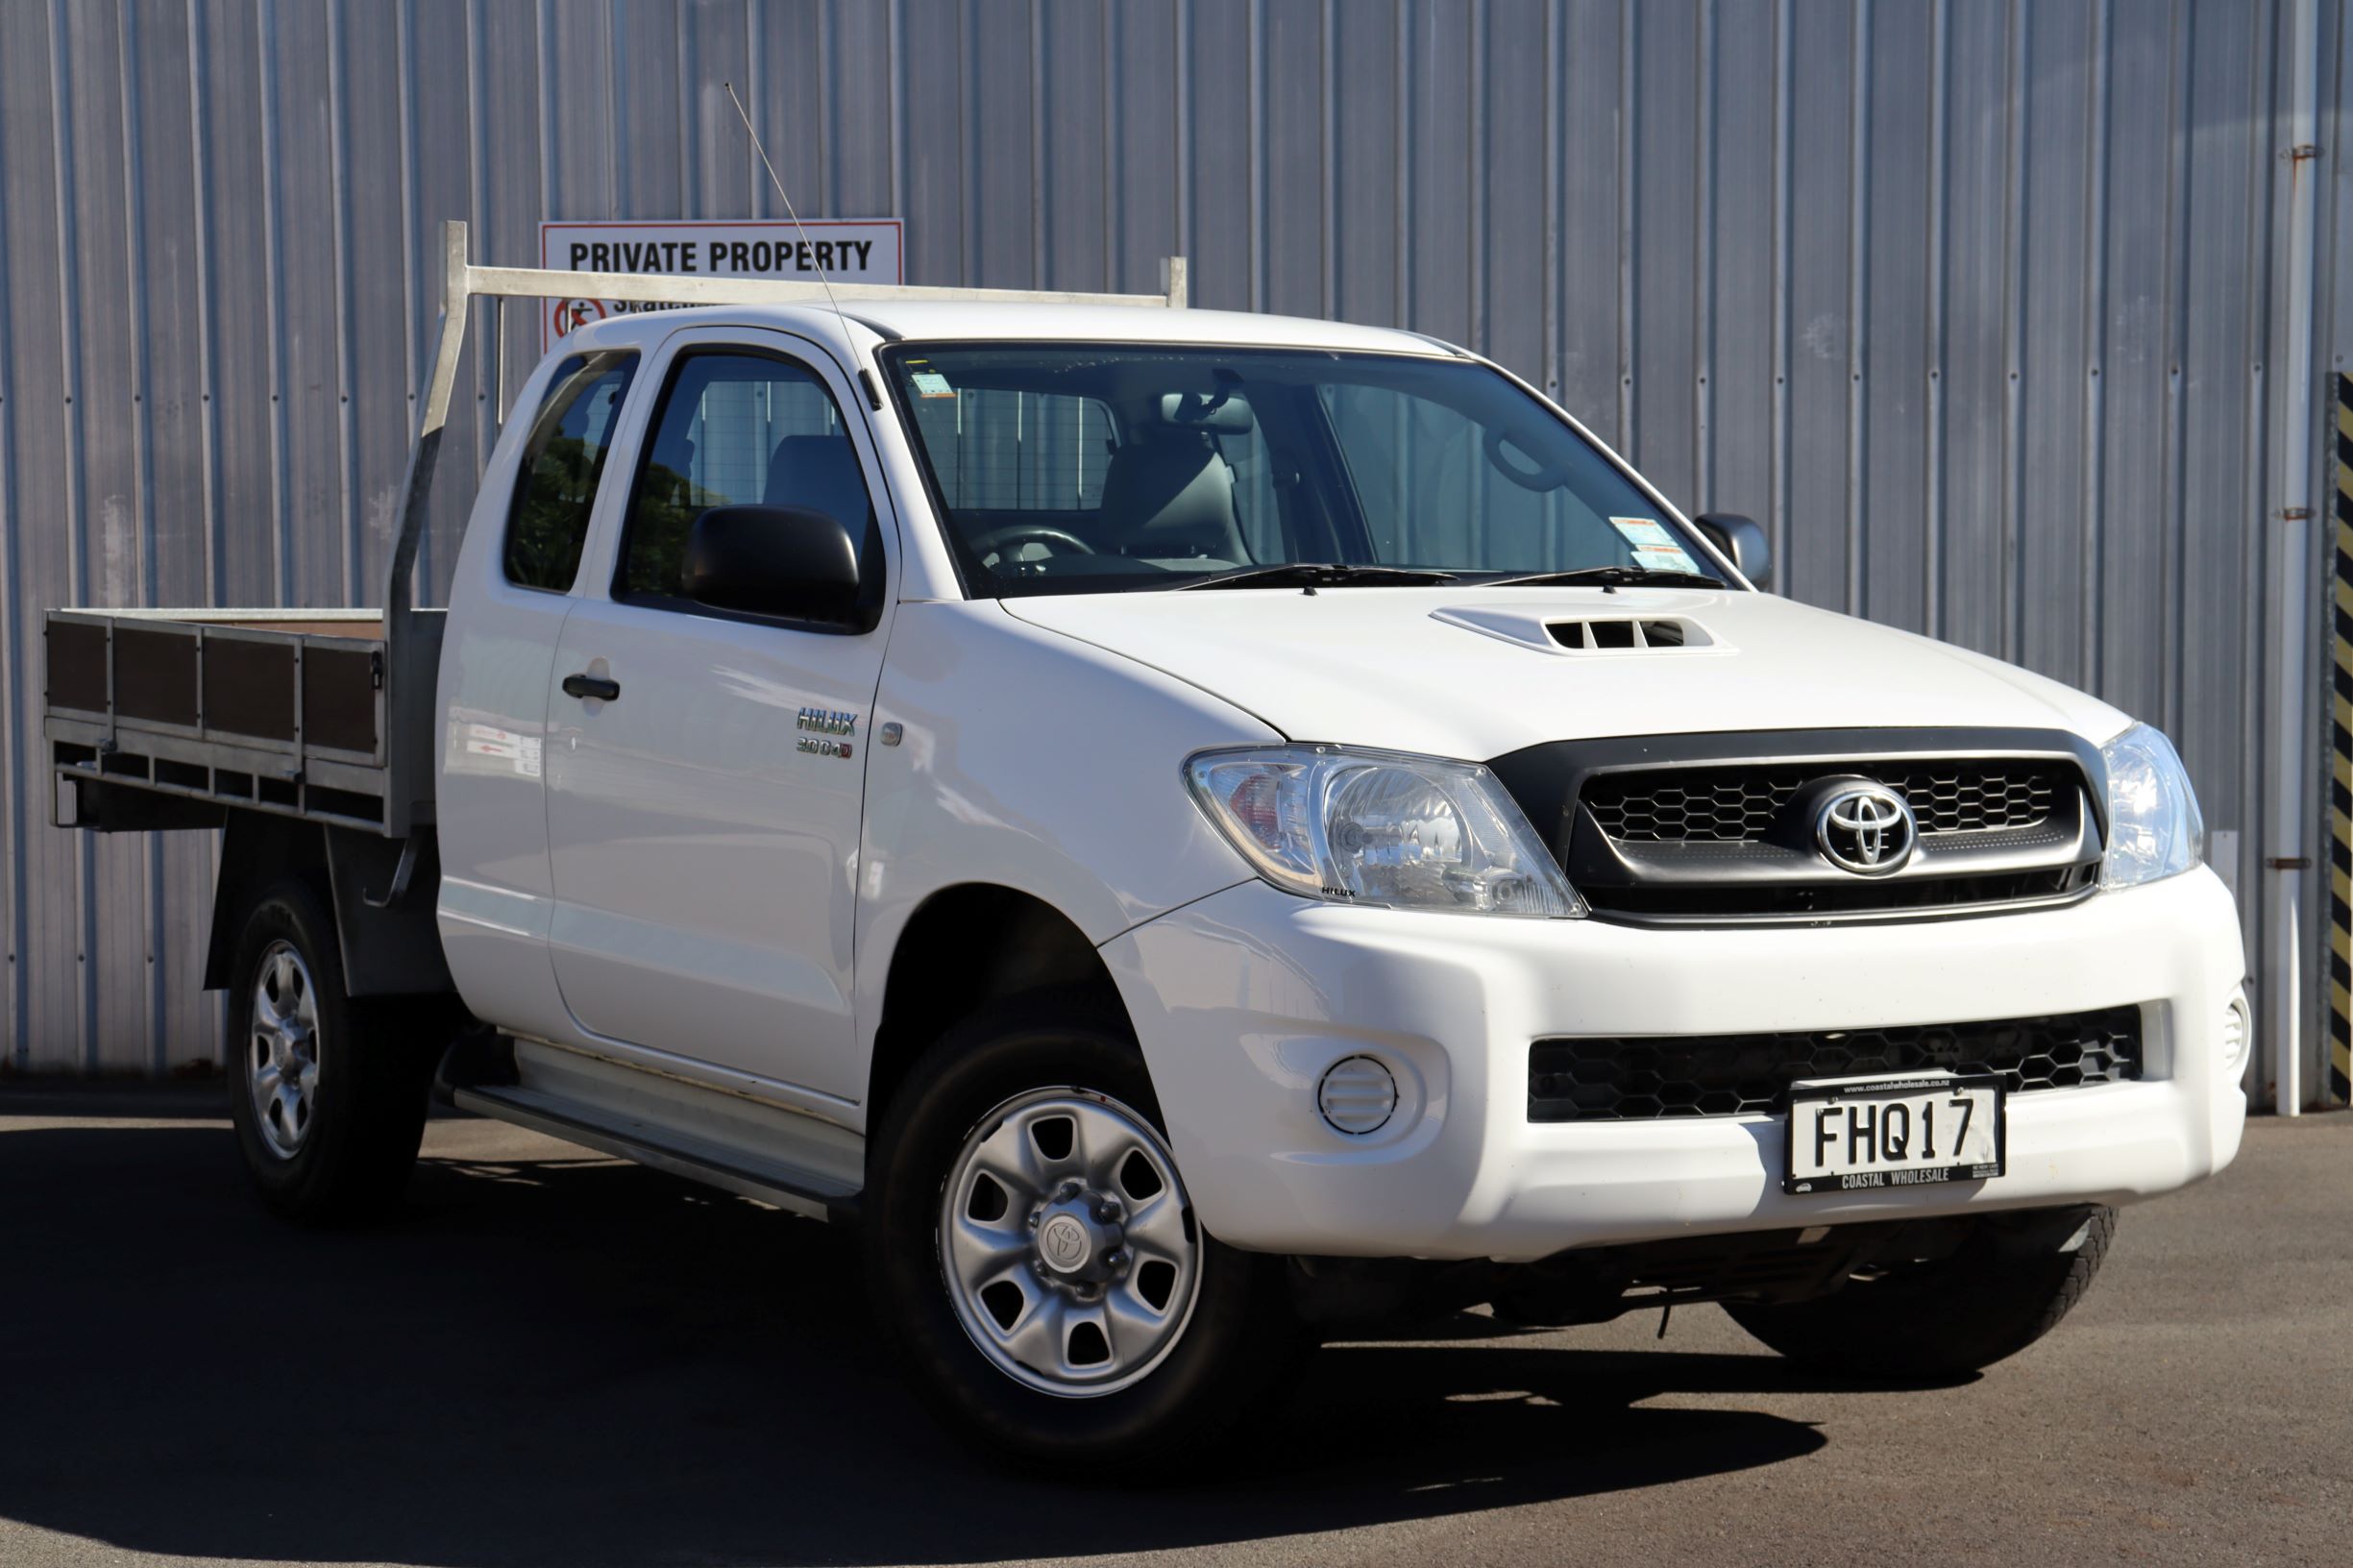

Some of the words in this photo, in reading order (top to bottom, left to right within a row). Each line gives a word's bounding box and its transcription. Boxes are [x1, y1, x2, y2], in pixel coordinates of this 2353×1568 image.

[570, 241, 698, 273] PRIVATE
[709, 239, 873, 273] PROPERTY
[797, 706, 858, 737] HILUX
[1321, 886, 1356, 897] HILUX
[1844, 1079, 1950, 1093] www.coastalwholesale.co.nz
[1815, 1098, 1974, 1167] FHQ17
[1842, 1172, 1885, 1189] COASTAL
[1890, 1167, 1950, 1186] WHOLESALE
